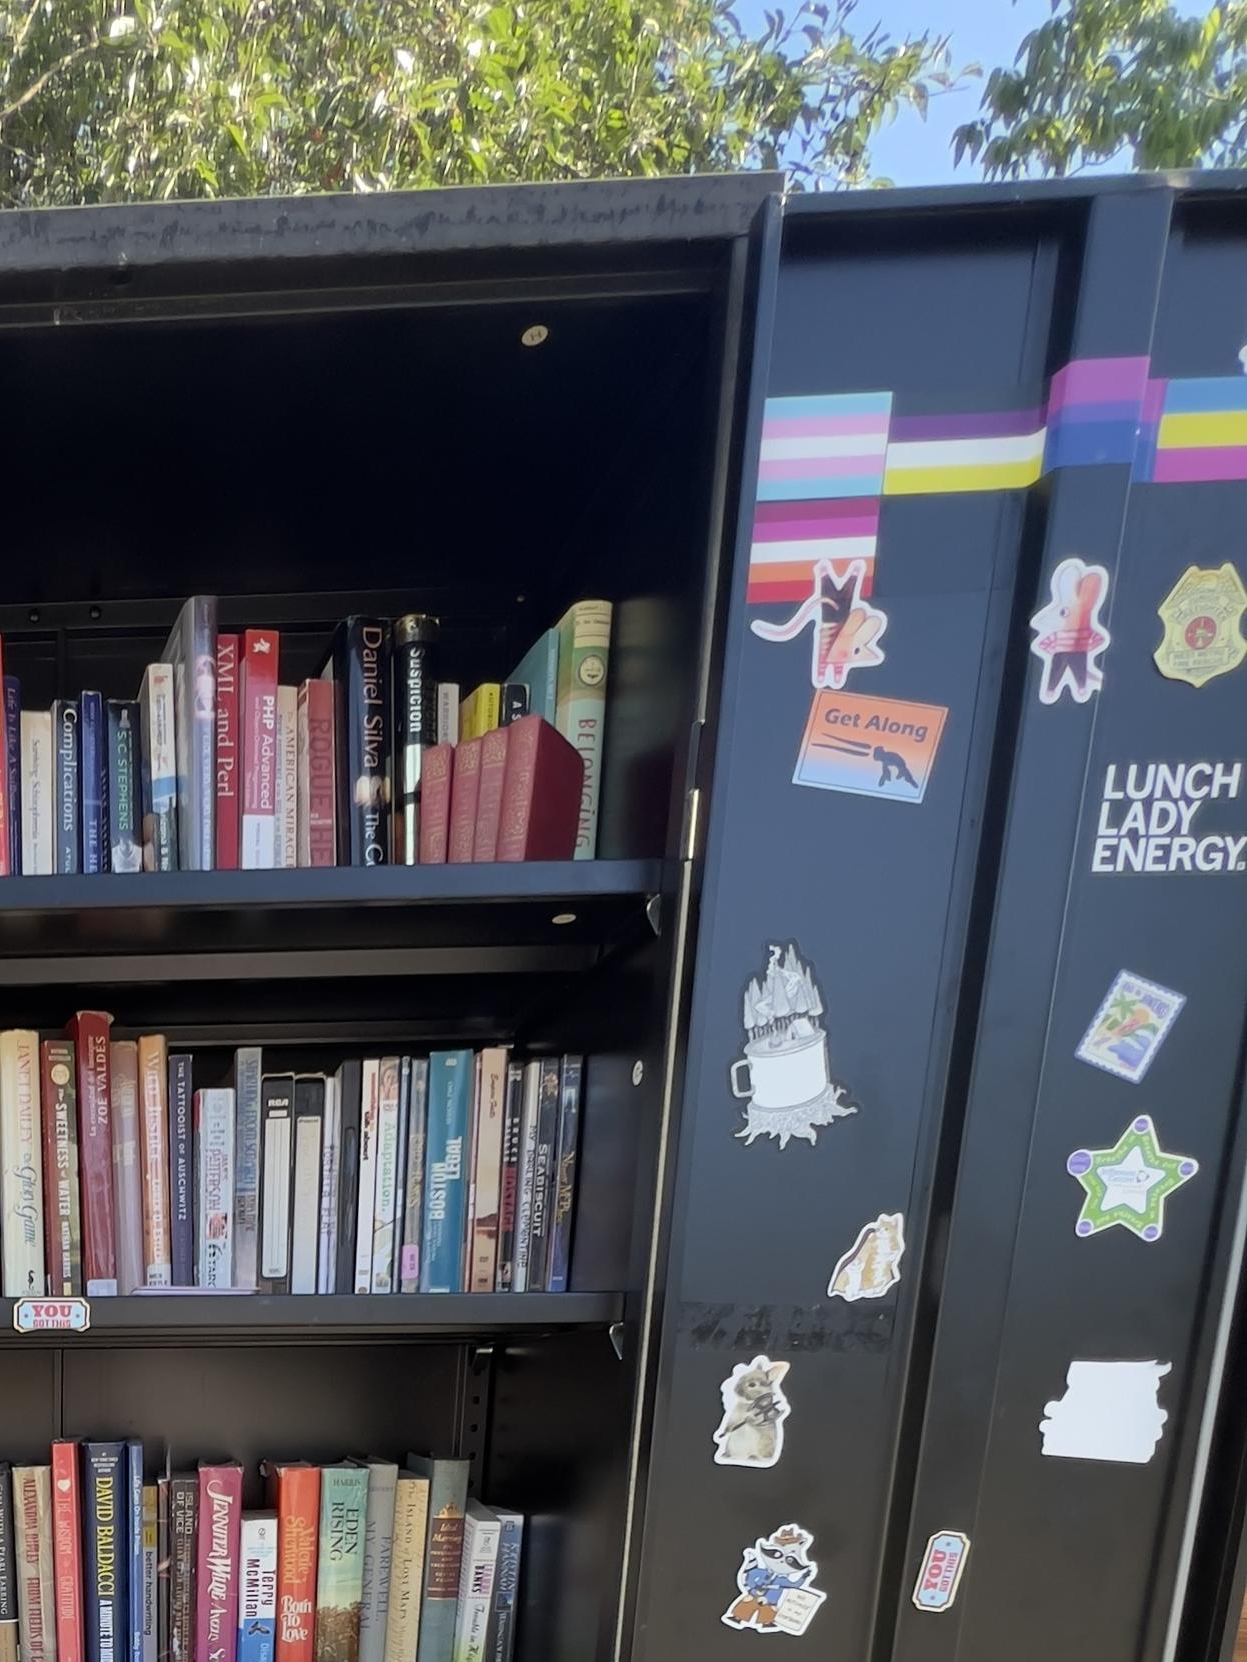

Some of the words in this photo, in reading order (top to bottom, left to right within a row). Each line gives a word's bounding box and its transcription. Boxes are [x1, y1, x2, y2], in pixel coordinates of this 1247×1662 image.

[217, 644, 234, 695] XML
[363, 627, 383, 704] Daniel
[407, 648, 423, 733] Suspicion
[217, 709, 234, 747] and
[261, 695, 275, 730] PHP
[824, 707, 860, 728] Get
[865, 713, 929, 743] Along
[364, 714, 384, 767] Silva
[59, 708, 78, 832] Complications
[217, 756, 234, 797] Perl
[260, 734, 275, 809] Advanced
[284, 726, 296, 800] AMERICAN
[310, 718, 333, 812] ROGUE
[1103, 763, 1242, 799] LUNCH
[117, 759, 129, 830] STEPHENS
[88, 820, 98, 848] THE
[364, 811, 380, 839] The
[1097, 800, 1204, 836] LADY
[17, 1044, 32, 1087] JANET
[177, 1061, 185, 1078] THE
[19, 1089, 34, 1144] DAILEY
[177, 1081, 186, 1139] TATTOOIST
[56, 1102, 68, 1168] SWEETNESS
[178, 1143, 185, 1154] OF
[511, 1117, 520, 1163] BRUCE
[445, 1136, 463, 1180] LEGAL
[58, 1181, 70, 1216] WATER
[177, 1158, 187, 1220] AUSCHWITZ
[429, 1161, 448, 1221] BOSTON
[532, 1143, 550, 1237] SEABISCUIT
[14, 1205, 39, 1247] Game
[32, 1304, 72, 1317] YOU
[22, 1477, 38, 1529] ALEXANDRA
[58, 1498, 72, 1513] THE
[95, 1476, 115, 1523] DAVID
[176, 1491, 184, 1505] OF
[184, 1491, 195, 1535] ISLAND
[59, 1521, 73, 1554] WISDOM
[176, 1510, 184, 1534] VICE
[330, 1502, 345, 1562] RISING
[344, 1508, 359, 1555] EDEN
[365, 1521, 376, 1543] MY
[405, 1504, 416, 1544] ISLAND
[96, 1525, 115, 1597] BALDACCI
[145, 1551, 155, 1580] better
[283, 1515, 303, 1585] Sherwood
[923, 1548, 947, 1591] YOU
[27, 1577, 42, 1607] FROM
[245, 1558, 261, 1617] McMillan
[261, 1569, 276, 1606] Terry
[402, 1559, 413, 1585] LOST
[0, 1575, 9, 1615] EARRING
[60, 1575, 74, 1621] GRATITUDE
[144, 1582, 155, 1636] handwriting
[281, 1595, 312, 1614] Born
[28, 1608, 43, 1639] FIELDS
[99, 1606, 113, 1637] MINUTE
[281, 1612, 300, 1626] To
[281, 1623, 309, 1643] Love
[30, 1641, 43, 1655] OF
[99, 1638, 113, 1648] TO
